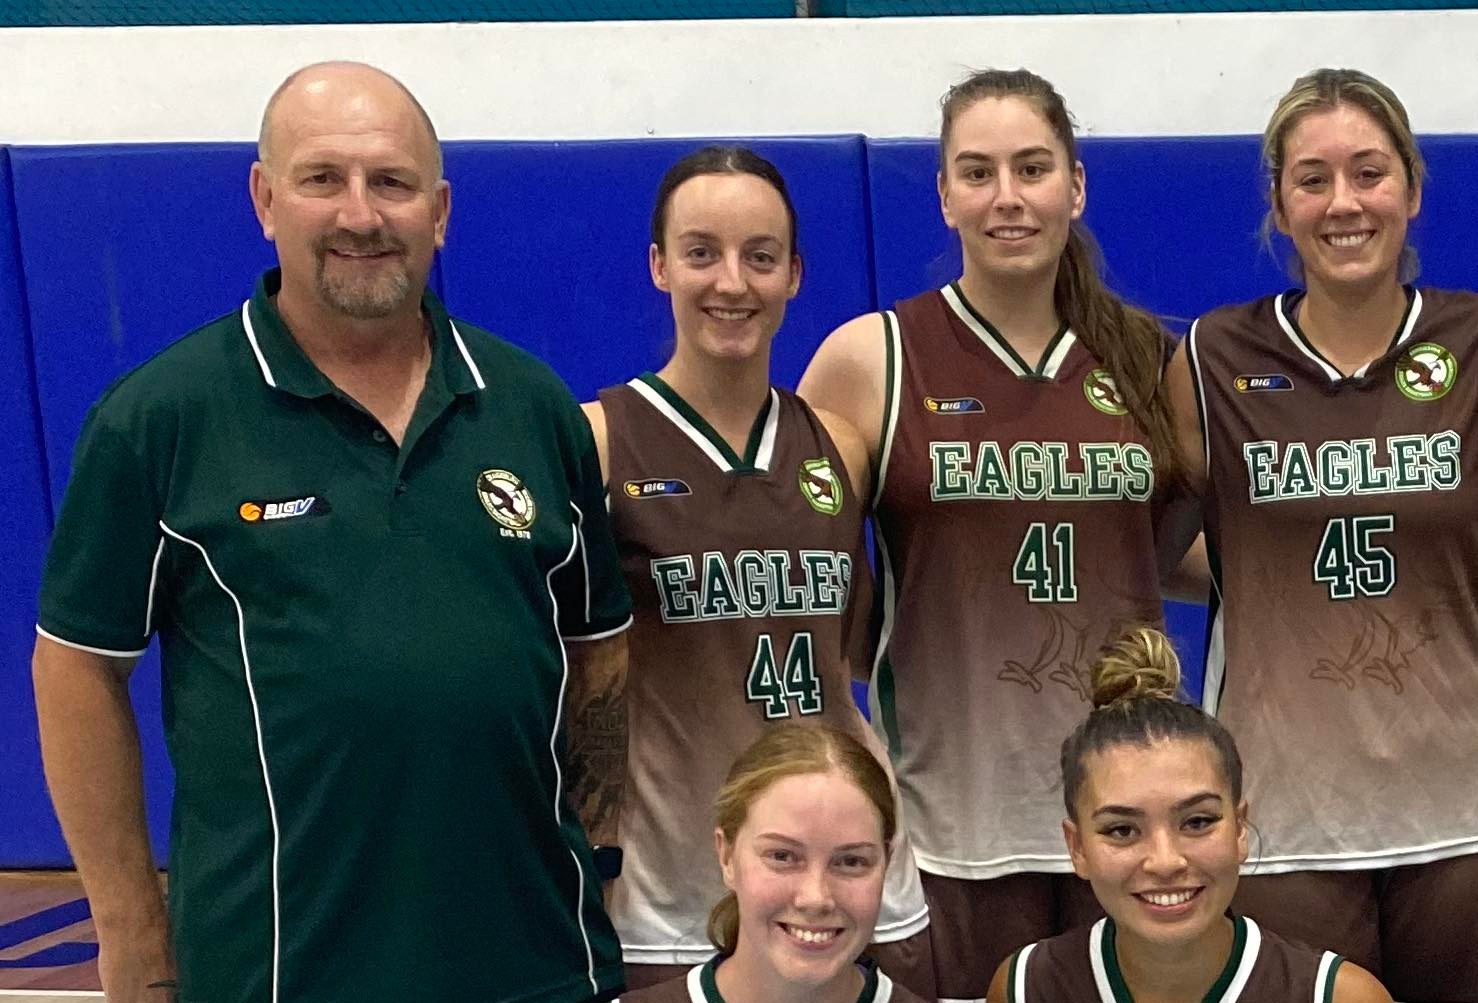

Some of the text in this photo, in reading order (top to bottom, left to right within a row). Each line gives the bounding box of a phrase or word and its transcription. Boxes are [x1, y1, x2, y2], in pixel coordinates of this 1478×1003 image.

[930, 442, 1155, 501] EAGLES
[1243, 430, 1462, 504] EAGLES
[650, 550, 852, 624] EAGLES
[1012, 522, 1077, 602] 41
[1314, 515, 1395, 598] 45
[747, 632, 822, 718] 44
